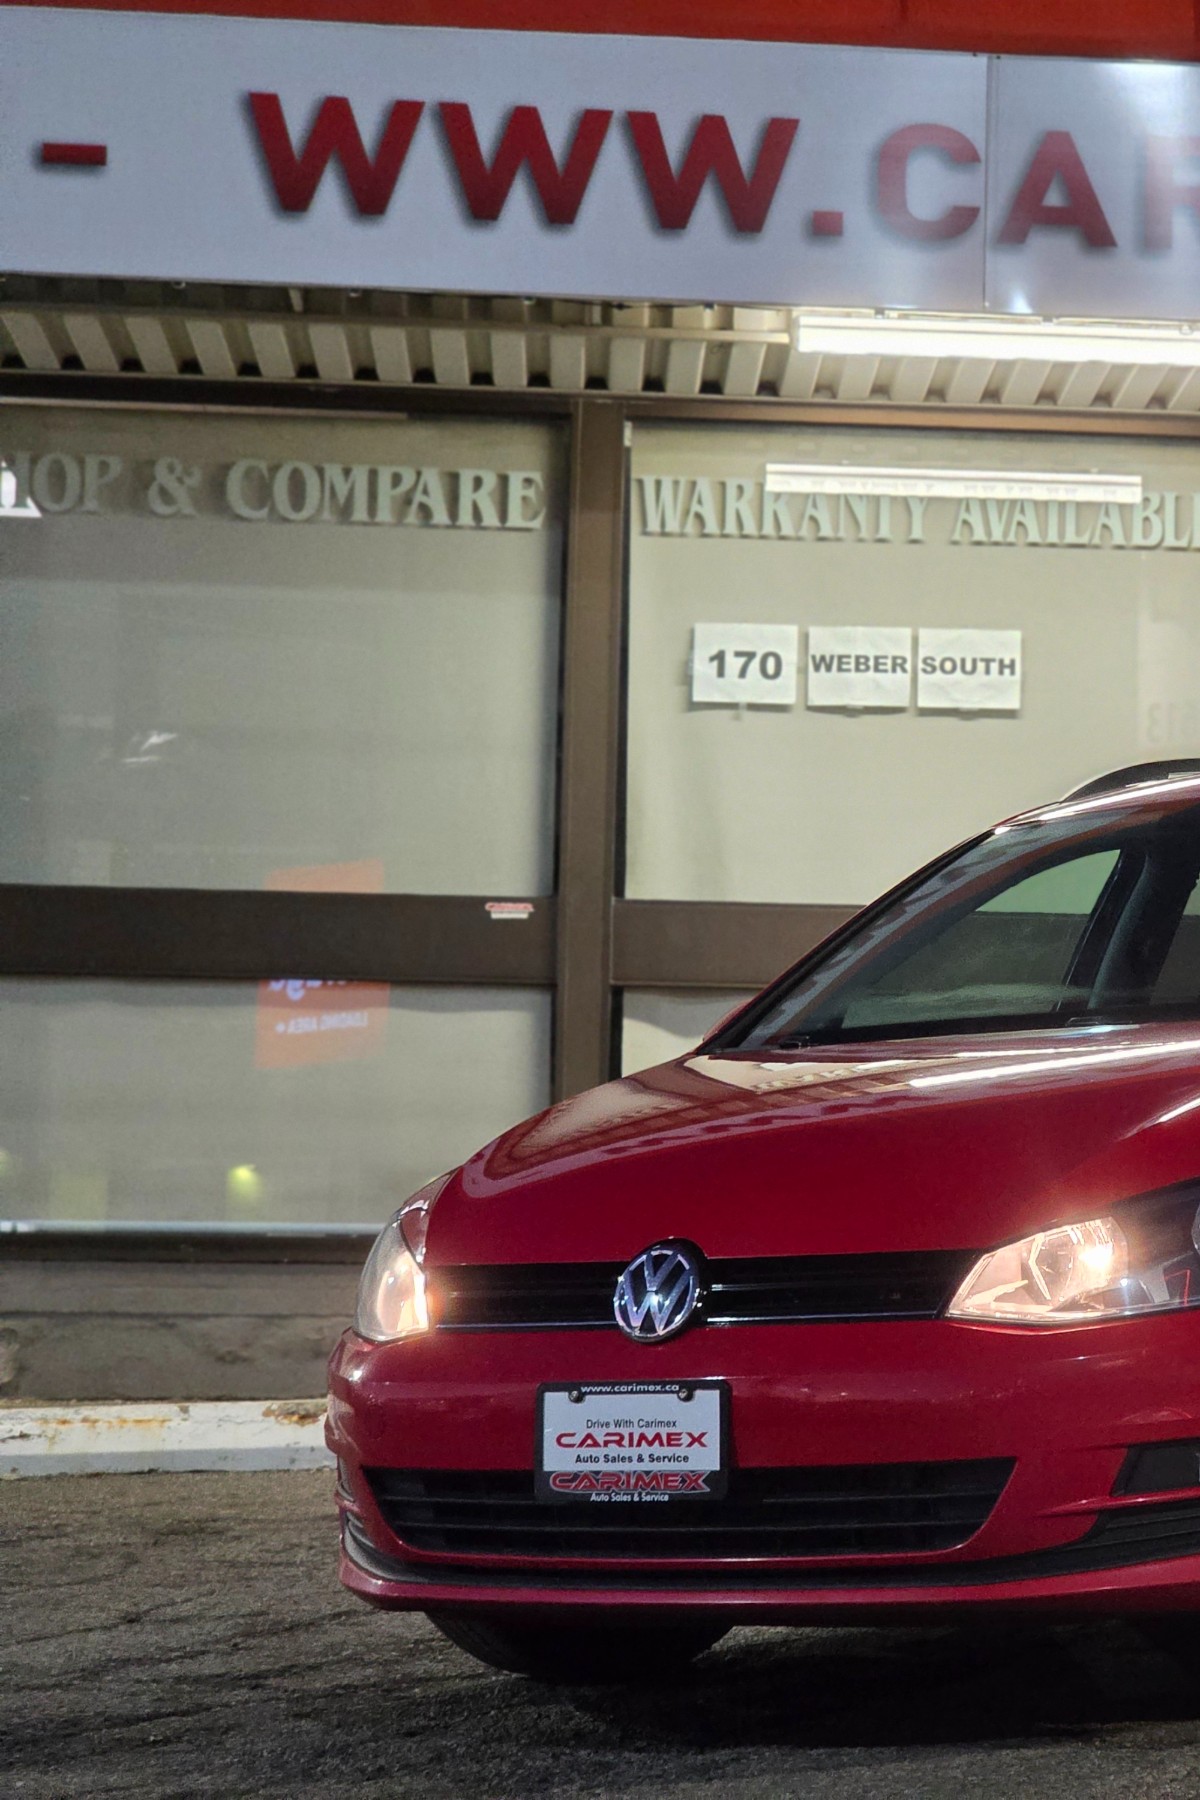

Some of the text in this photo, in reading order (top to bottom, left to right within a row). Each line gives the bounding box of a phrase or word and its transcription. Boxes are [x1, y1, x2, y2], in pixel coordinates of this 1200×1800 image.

[148, 456, 201, 517] &
[225, 458, 546, 531] COMPARE
[708, 649, 1017, 681] 170 WEBER SOUTH
[580, 1383, 680, 1393] www.carimex.ca
[586, 1418, 677, 1429] Drive With Carimex
[555, 1431, 709, 1449] CARIMEX
[575, 1453, 690, 1464] Auto Sales & Service
[551, 1470, 708, 1492] CARIMEX
[590, 1493, 609, 1502] Auto
[611, 1492, 631, 1502] Sales
[641, 1492, 669, 1502] Service
